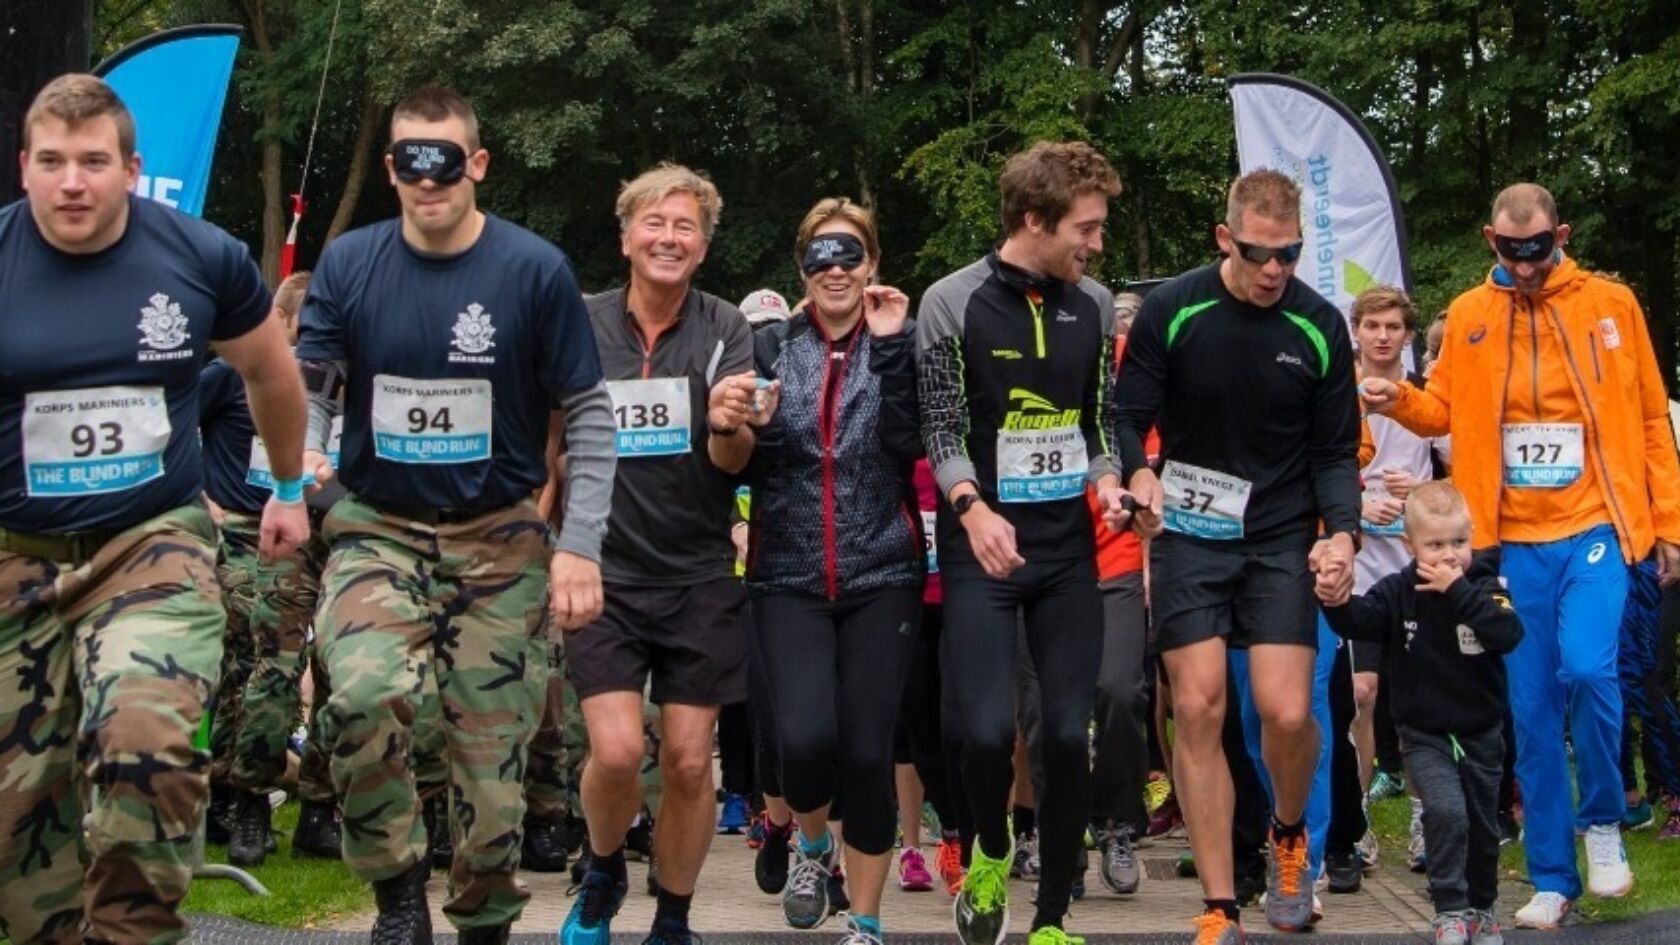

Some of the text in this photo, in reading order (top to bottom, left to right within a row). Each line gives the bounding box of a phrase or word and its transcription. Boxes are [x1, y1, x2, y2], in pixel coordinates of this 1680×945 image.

[382, 384, 473, 397] KORPS MARINIERS
[34, 397, 146, 415] KORPS MARINIERS
[614, 402, 670, 429] 138
[407, 407, 455, 434] 94
[70, 420, 125, 459] 93
[378, 437, 480, 459] THE BLIND RUN
[620, 432, 682, 451] BLIND RUN
[1029, 450, 1064, 475] 38
[1517, 443, 1563, 464] 127
[33, 466, 65, 485] THE
[69, 462, 122, 489] BLIND
[1179, 487, 1215, 515] 37
